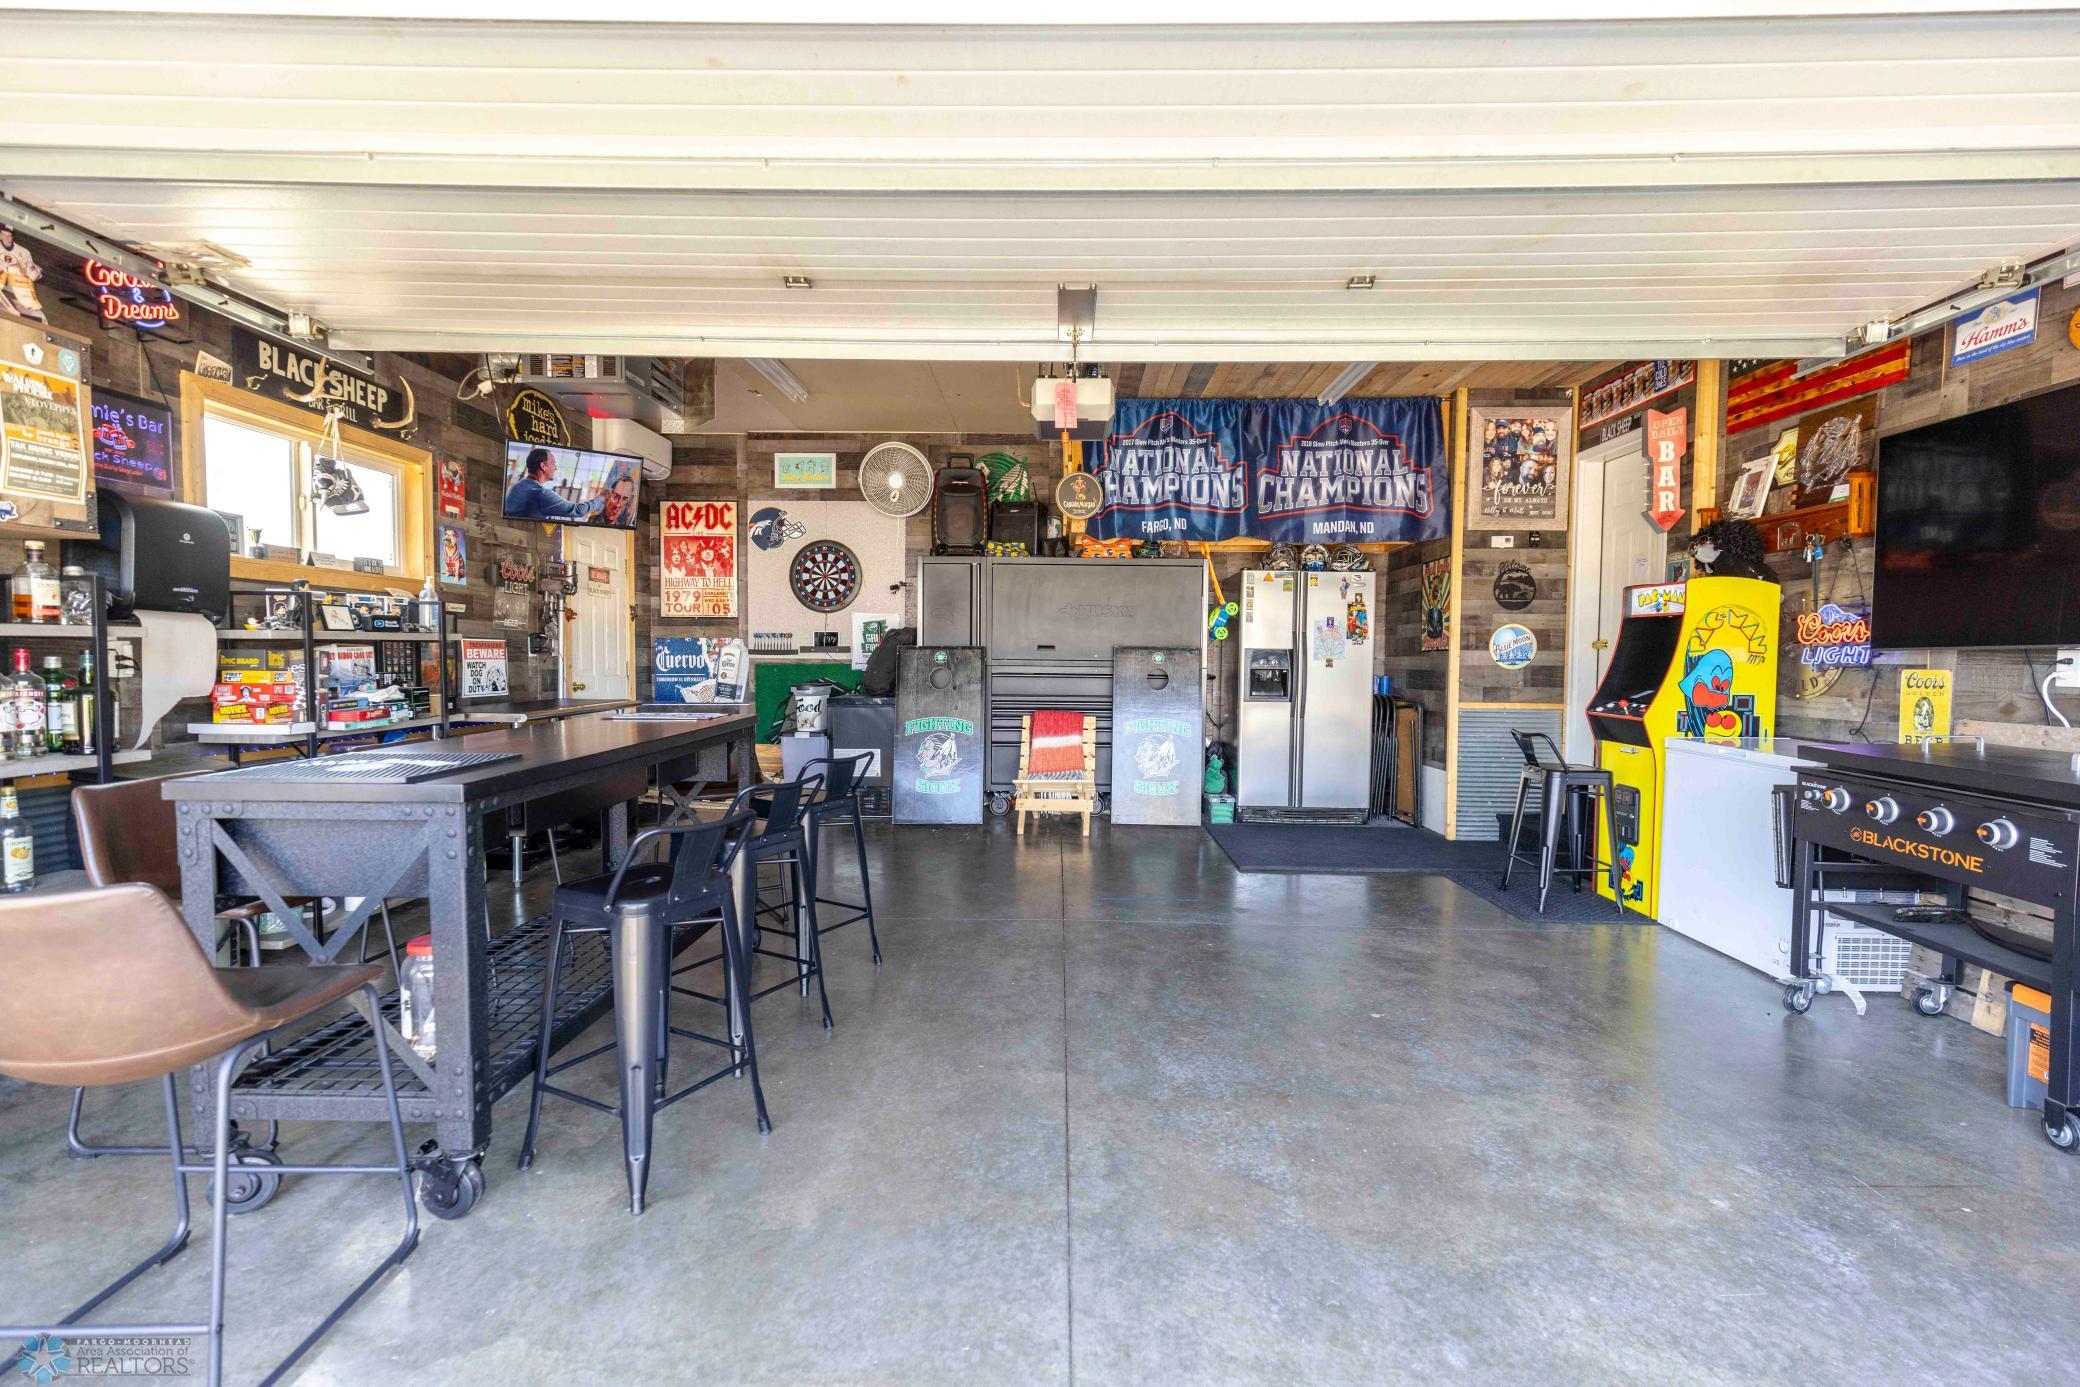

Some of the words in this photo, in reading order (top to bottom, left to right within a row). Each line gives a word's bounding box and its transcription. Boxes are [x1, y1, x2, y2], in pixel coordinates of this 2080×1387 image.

[100, 294, 180, 320] Dreams
[1960, 317, 2030, 352] Hamm's
[329, 369, 388, 413] SHEEP
[522, 397, 555, 424] mike's
[138, 414, 164, 434] Bar
[531, 415, 558, 438] hard
[1601, 422, 1617, 443] BLACK
[1616, 416, 1633, 437] SHEEP
[1651, 424, 1685, 440] DAILY
[1653, 416, 1684, 429] OPEN
[1134, 438, 1147, 446] Slow
[1325, 439, 1338, 447] Pitch
[112, 454, 153, 472] Sheep
[1110, 446, 1224, 477] NATIONAL
[1281, 449, 1408, 477] NATIONAL
[1658, 441, 1677, 512] BAR
[1103, 466, 1247, 512] HAMPIONS
[1258, 473, 1428, 514] CHAMPIONS
[1494, 479, 1547, 505] forever
[1063, 500, 1080, 508] Captain
[1080, 500, 1096, 509] Morgan
[1141, 519, 1172, 533] FARGO,
[1173, 517, 1187, 531] ND
[1313, 521, 1358, 535] MANDAN,
[1360, 521, 1375, 534] ND
[501, 559, 535, 582] Coors
[504, 581, 529, 596] LIGHT
[665, 577, 699, 588] HIGHWAY
[701, 577, 711, 588] TO
[713, 577, 733, 588] HELL
[665, 590, 702, 602] 1979
[1638, 589, 1685, 607] PAC-MAN
[665, 602, 701, 613] TOUR
[1689, 609, 1767, 654] PAC-MAN
[1798, 612, 1870, 645] Coors
[1512, 635, 1531, 648] MOON
[466, 648, 505, 659] BEWARE
[656, 645, 705, 672] Cuervo
[1801, 645, 1870, 664] LIGHT
[467, 661, 486, 669] WATCH
[468, 685, 486, 693] DUTY
[1906, 671, 1946, 690] Coors
[905, 716, 974, 737] FIGHTING
[1124, 717, 1193, 738] FIGHTING
[1905, 734, 1944, 745] BER
[915, 778, 961, 794] SIOUX
[1133, 779, 1181, 796] SIOUX
[1801, 781, 1828, 790] BLACKSTONE
[1863, 831, 1984, 874] BLACKSTONE
